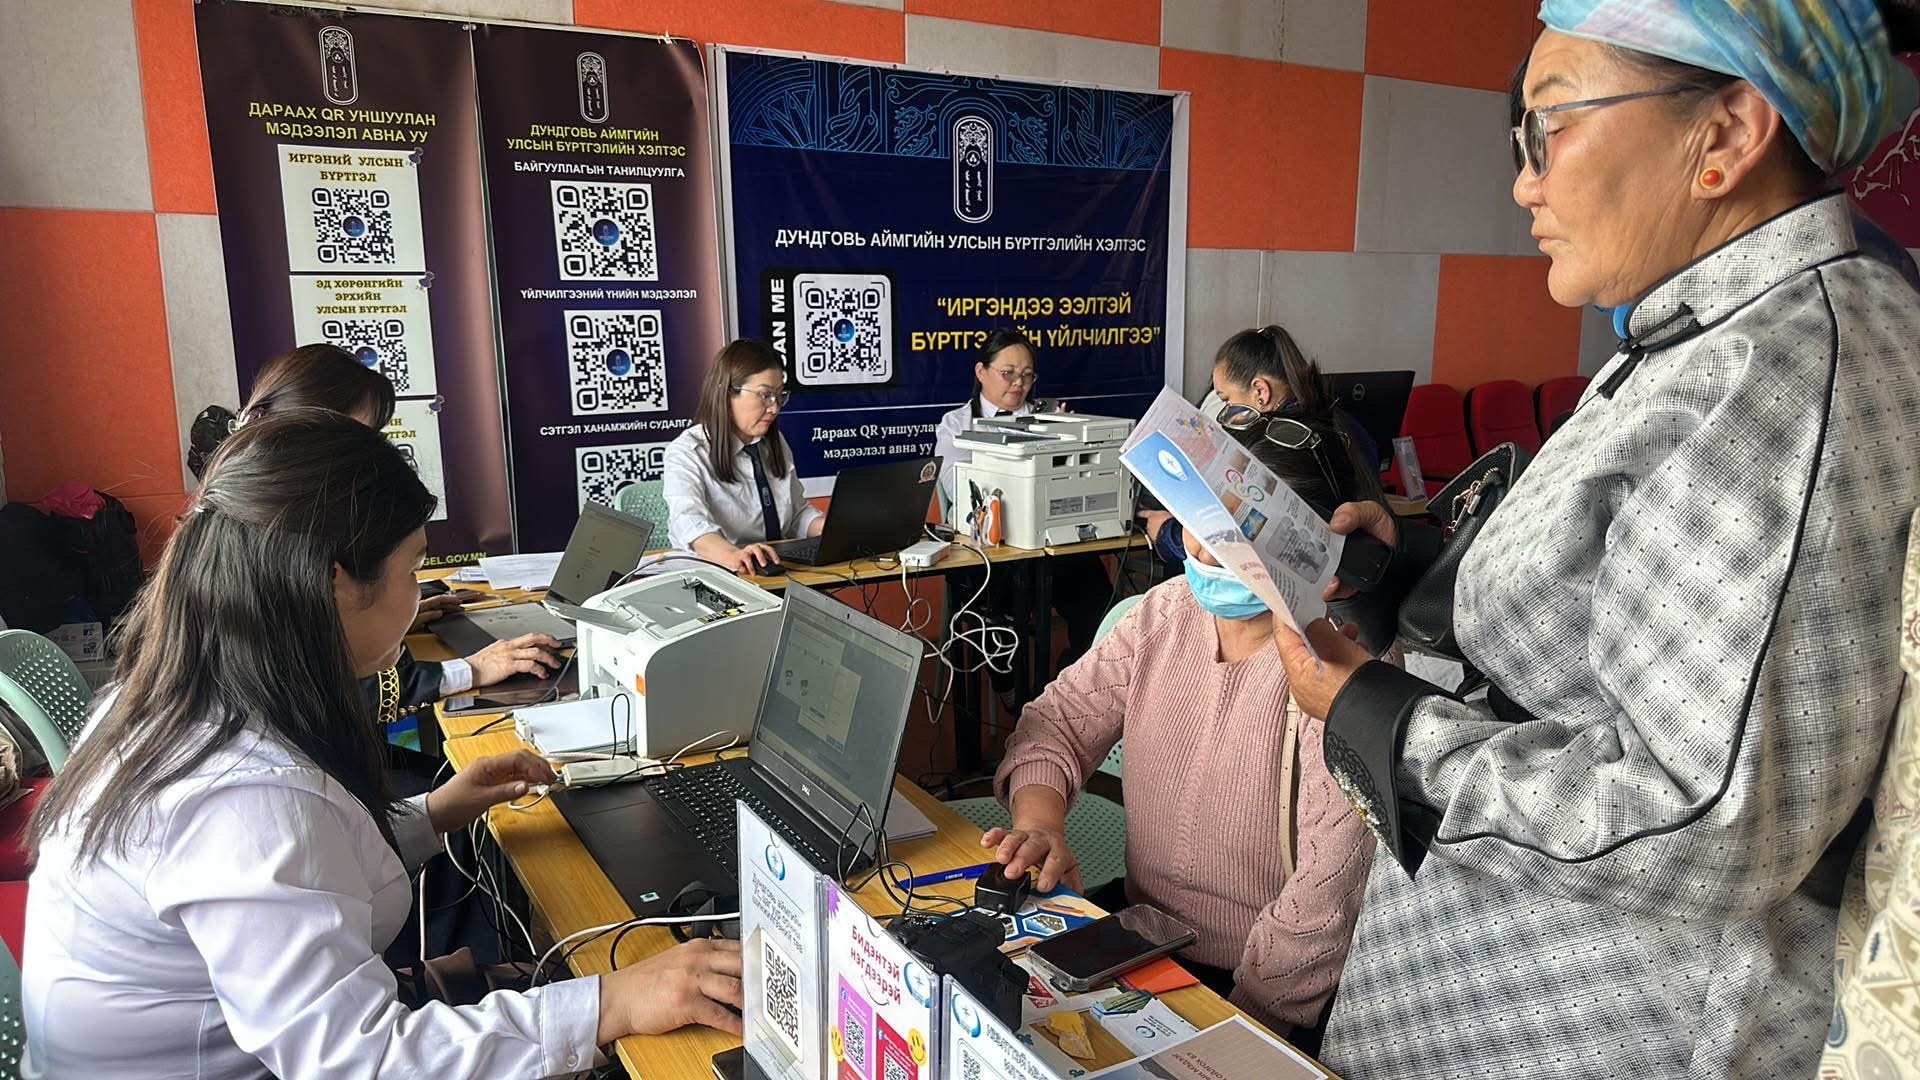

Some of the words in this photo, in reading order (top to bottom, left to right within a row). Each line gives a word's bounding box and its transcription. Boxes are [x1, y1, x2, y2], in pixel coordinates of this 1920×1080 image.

[249, 102, 317, 120] ДАРААХ
[321, 107, 344, 121] QR
[349, 109, 436, 126] УНШУУЛАН
[266, 122, 357, 140] МЭДЭЭЛЭЛ
[362, 128, 406, 142] АВНА
[410, 130, 428, 143] УУ
[530, 124, 597, 138] ДУНДГОВЬ
[600, 126, 659, 141] АЙМГИЙН
[507, 138, 553, 151] УЛСЫН
[556, 140, 635, 155] БҮРТГЭЛИЙН
[638, 144, 686, 157] ХЭЛТЭС
[288, 152, 352, 165] ИРГЭНИЙ
[358, 155, 404, 167] УЛСЫН
[319, 170, 377, 183] БҮРТГЭЛ
[514, 160, 604, 176] БАЙГУУЛЛАГЫН
[607, 165, 685, 178] ТАНИЛЦУУЛГА
[775, 229, 866, 249] ДУНДГОВЬ
[870, 229, 944, 249] АЙМГИЙН
[948, 234, 1002, 250] УЛСЫН
[1005, 235, 1093, 251] БҮРТГЭЛИЙН
[1096, 238, 1147, 252] ХЭЛТЭС
[316, 279, 332, 289] ЭД
[333, 278, 403, 288] ХӨРӨНГИЙН
[335, 292, 381, 301] ЭРХИЙН
[520, 288, 604, 299] ҮЙЛЧИЛГЭЭНИЙ
[606, 289, 639, 299] ҮНИЙН
[641, 289, 697, 300] МЭДЭЭЛЭЛ
[770, 278, 786, 313] ME
[316, 305, 356, 315] УЛСЫН
[359, 305, 407, 314] БҮРТГЭЛ
[937, 297, 1054, 320] “ИРГЭНДЭЭ
[1058, 292, 1132, 315] ЭЭЛТЭЙ
[911, 325, 1042, 351] БҮРТГЭН
[1047, 325, 1161, 347] ҮЙЛЧИЛГЭЭ”
[772, 321, 788, 384] AN
[540, 424, 582, 436] СЭТГЭЛ
[583, 419, 648, 434] ХАНАМЖИЙН
[649, 418, 693, 431] СУДАЛГА
[812, 427, 857, 442] Дараах
[860, 424, 878, 439] QR
[823, 445, 886, 459] мэдээлэл
[888, 443, 917, 455] авна
[919, 442, 933, 455] уу
[423, 551, 487, 567] GEL.GOV.MN
[851, 924, 900, 981] Бидэнтэй
[850, 947, 901, 1004] нэгдээрэй
